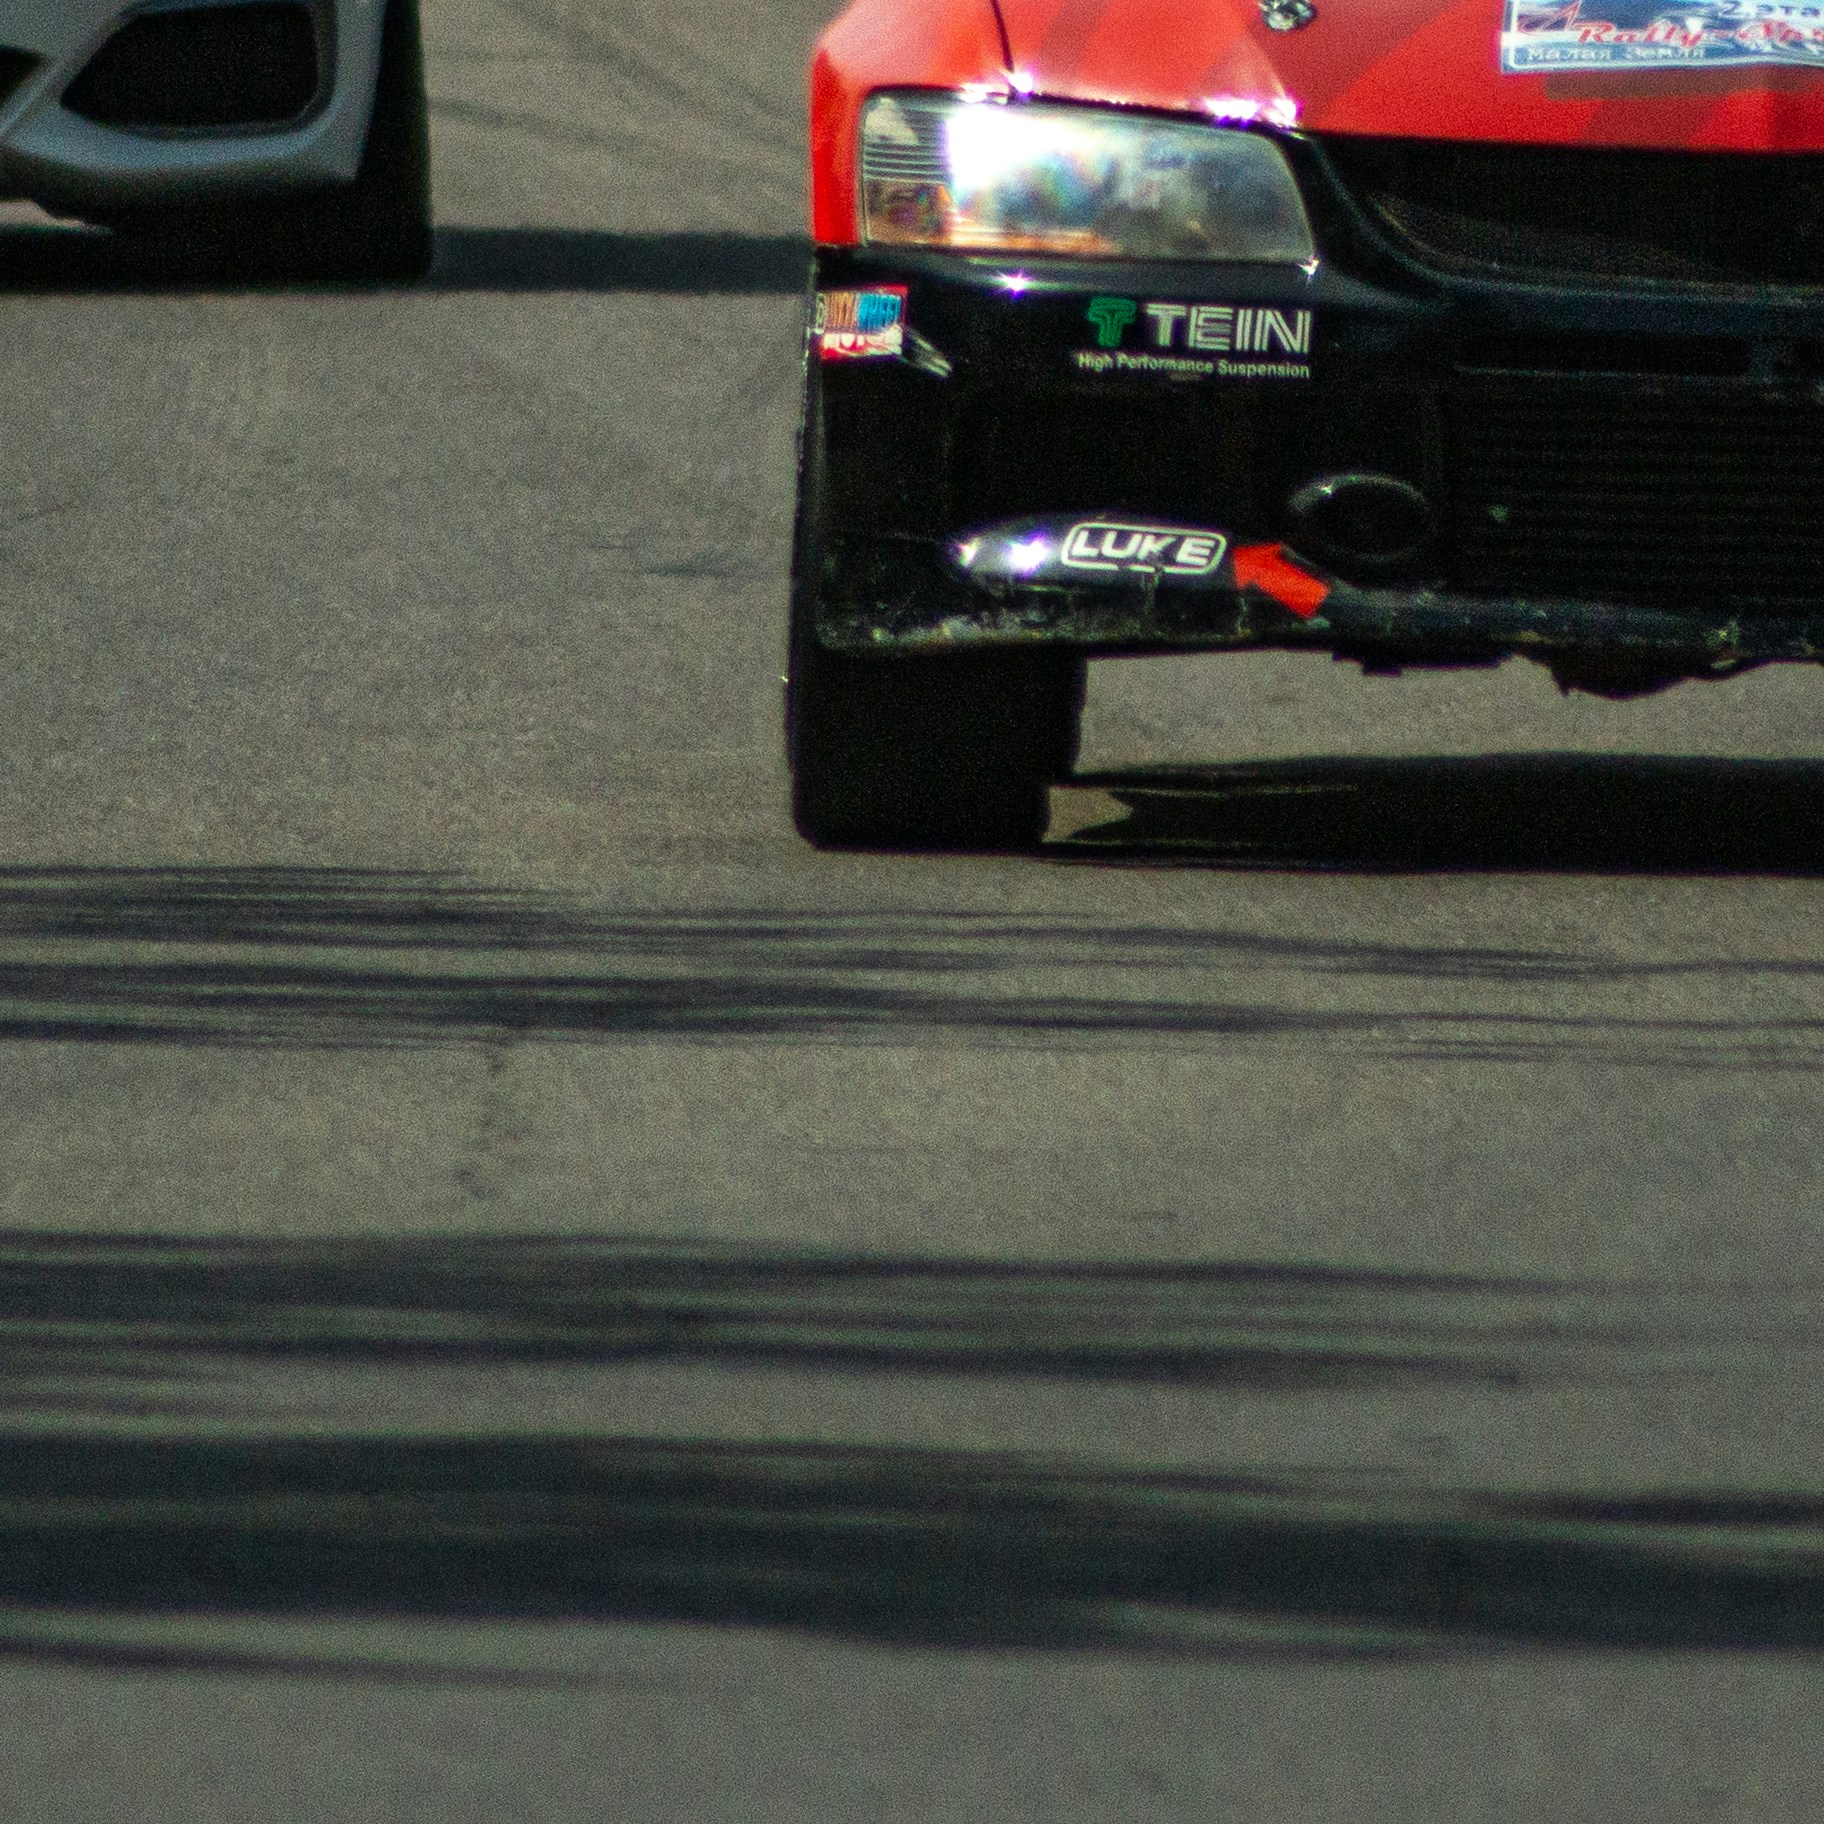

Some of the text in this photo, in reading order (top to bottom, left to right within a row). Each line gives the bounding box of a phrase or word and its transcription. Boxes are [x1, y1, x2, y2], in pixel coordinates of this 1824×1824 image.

[1145, 302, 1312, 355] TEIN
[1077, 352, 1310, 379] High Performance Suspension
[1071, 529, 1216, 567] LUKE
